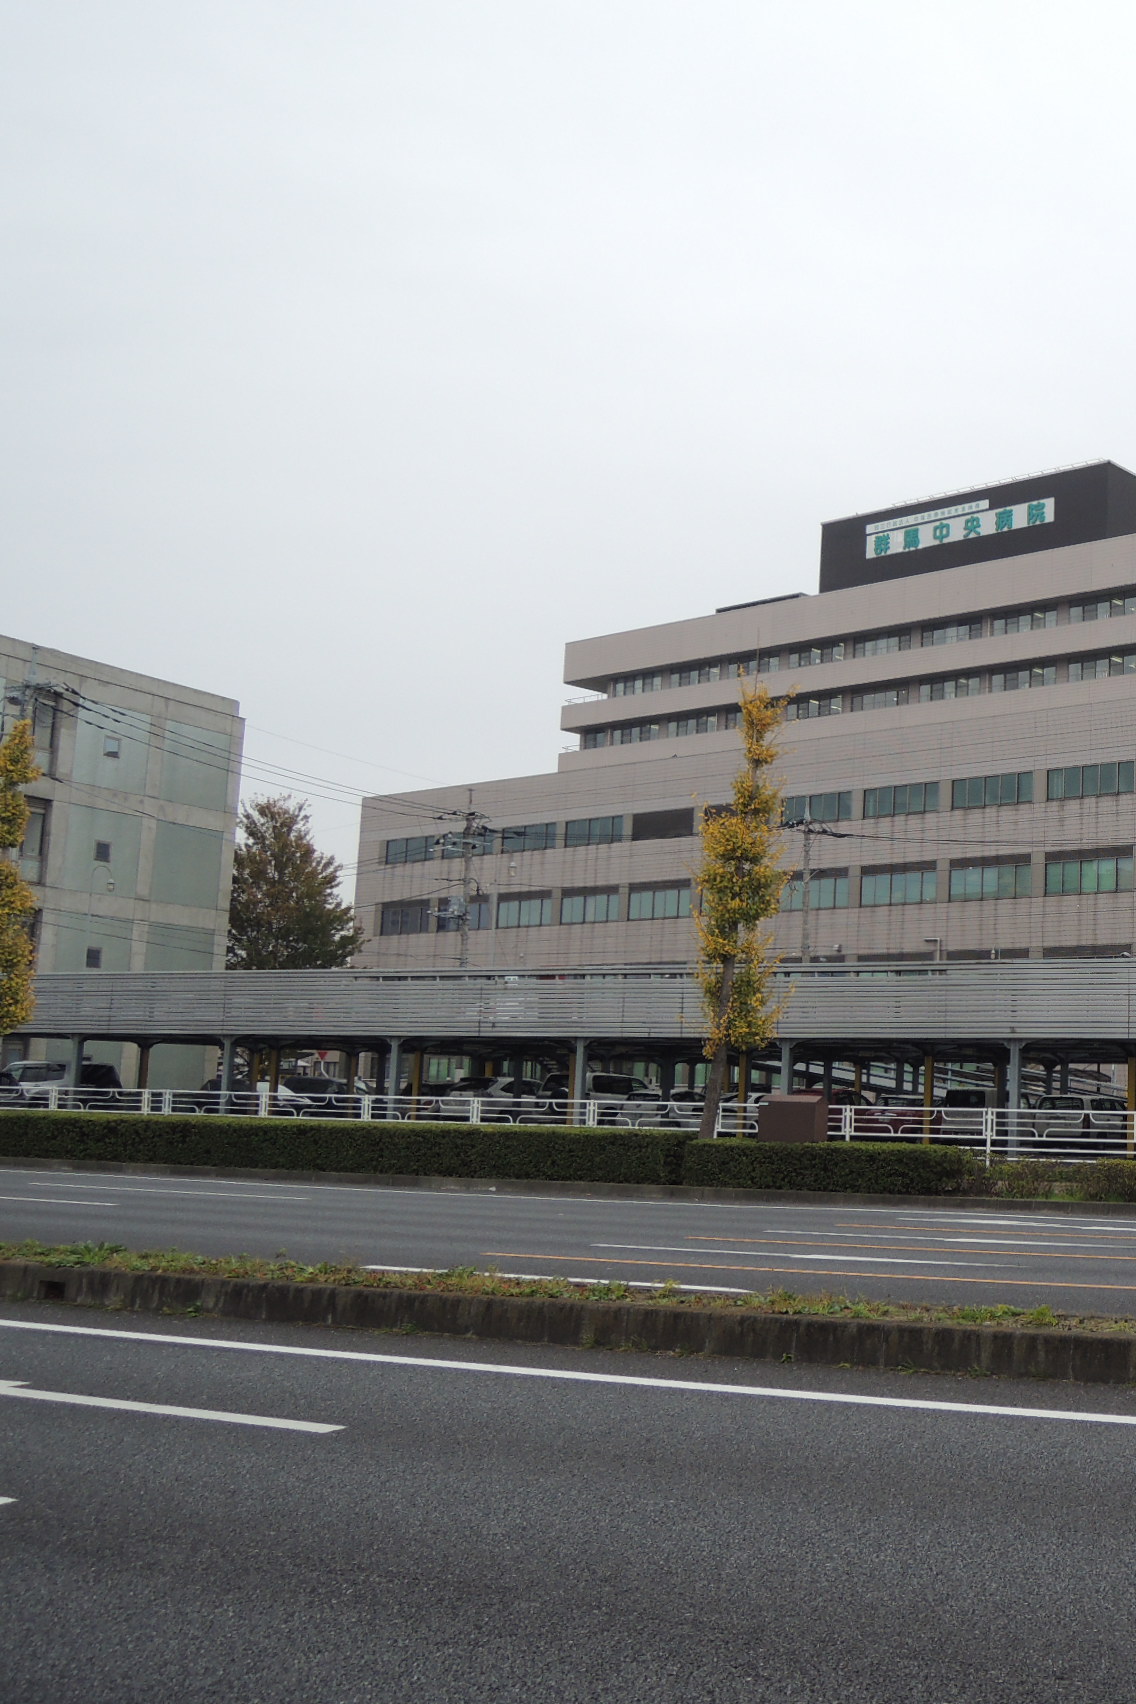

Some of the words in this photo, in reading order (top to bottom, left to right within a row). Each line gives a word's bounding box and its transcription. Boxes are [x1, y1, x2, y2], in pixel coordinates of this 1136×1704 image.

[873, 501, 1046, 556] 群馬中央病院
